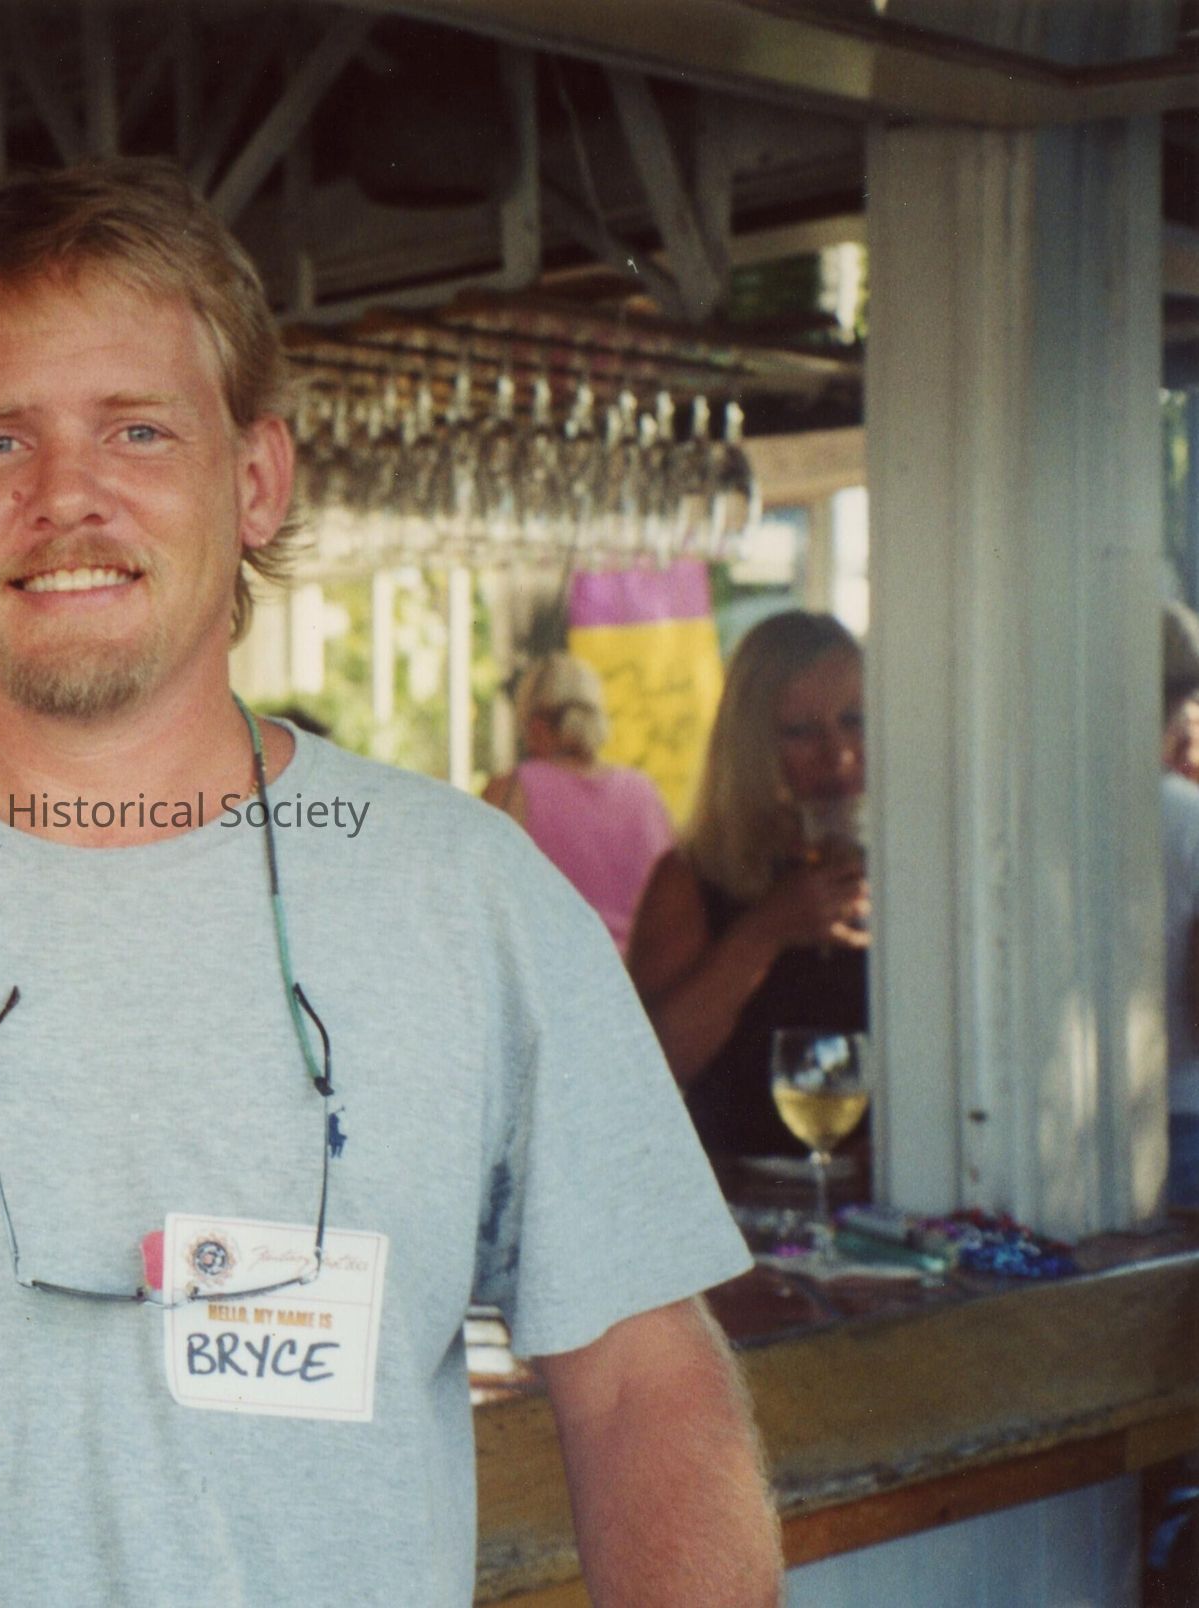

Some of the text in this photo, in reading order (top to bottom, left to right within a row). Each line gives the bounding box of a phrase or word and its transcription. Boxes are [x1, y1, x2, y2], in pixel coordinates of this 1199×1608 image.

[254, 1307, 273, 1325] MY
[276, 1309, 315, 1328] NAME
[318, 1311, 333, 1329] IS
[186, 1331, 341, 1383] BRYCE
